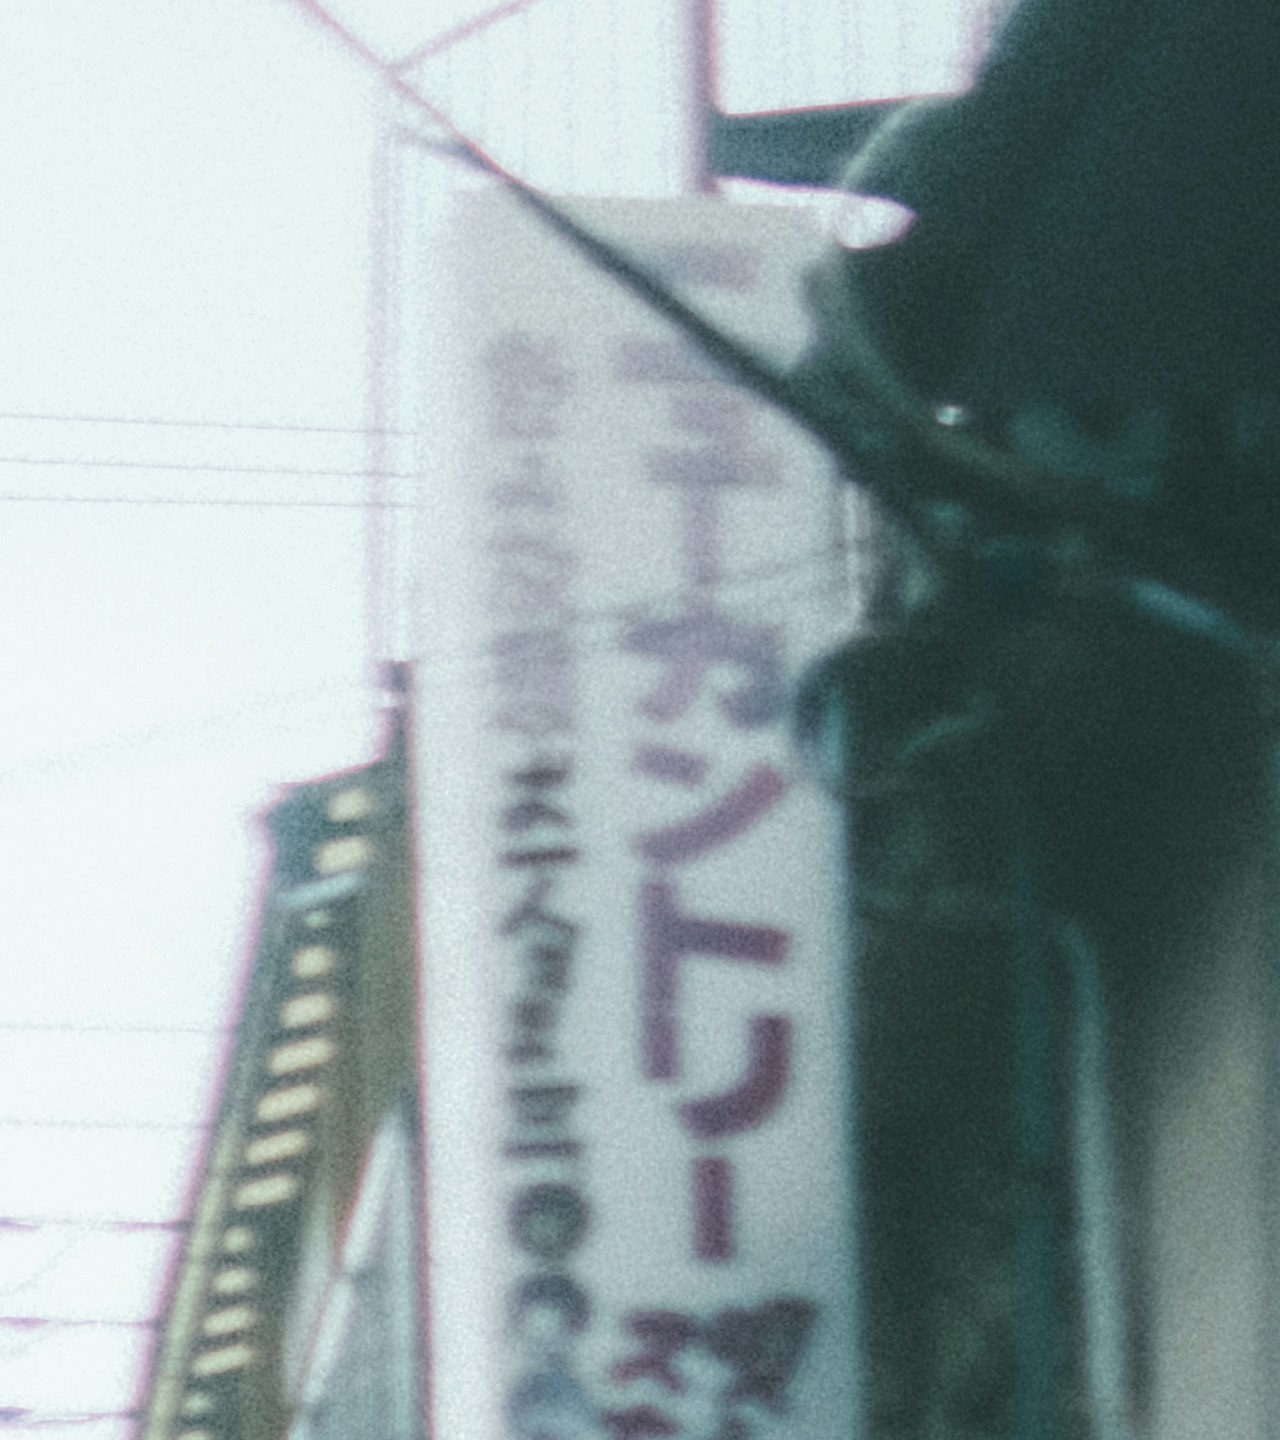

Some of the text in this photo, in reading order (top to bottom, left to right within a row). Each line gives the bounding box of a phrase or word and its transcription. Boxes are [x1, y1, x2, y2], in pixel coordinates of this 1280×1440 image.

[615, 243, 795, 1264] ニューカントリー
